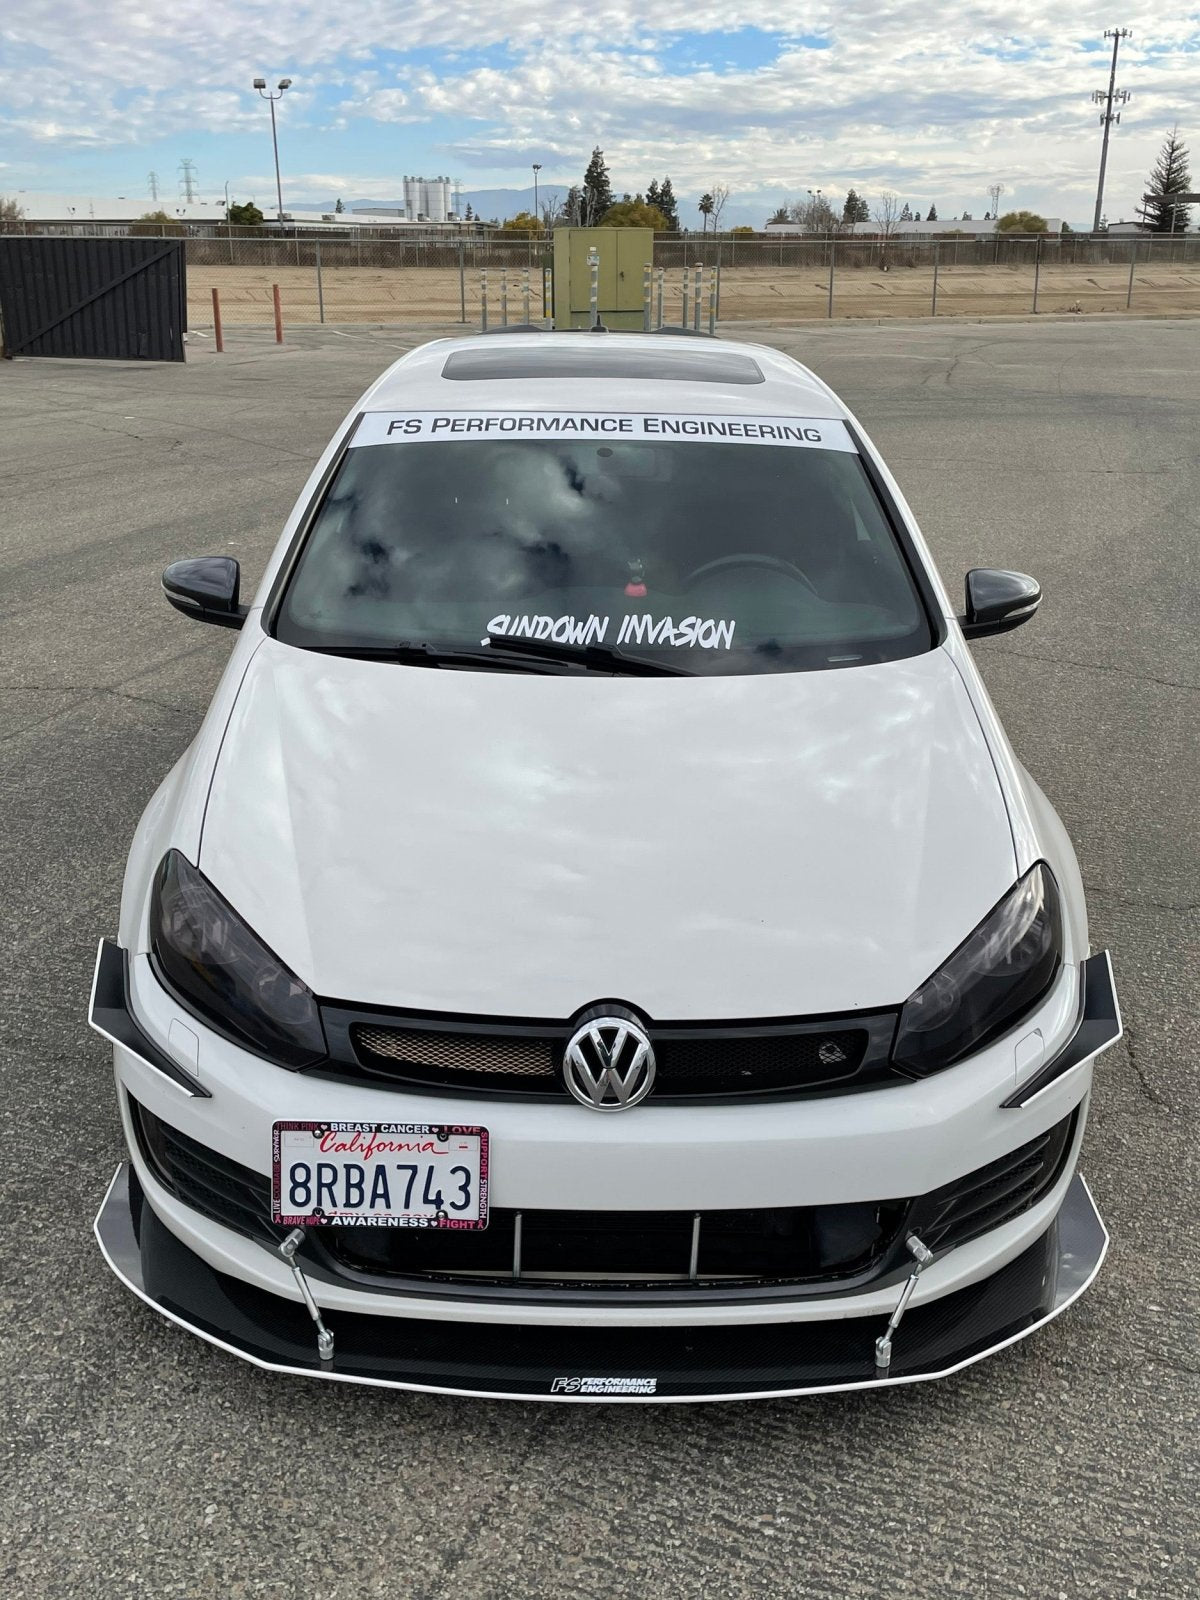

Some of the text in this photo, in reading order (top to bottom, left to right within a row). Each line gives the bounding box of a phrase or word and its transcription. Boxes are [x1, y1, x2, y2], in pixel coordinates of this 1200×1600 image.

[386, 417, 822, 443] FS PERFORMANCE ENGINEERING
[480, 614, 735, 650] SUNDOWN INVASION
[330, 1123, 430, 1134] BREAST CANCER
[443, 1126, 481, 1135] LOVE
[320, 1131, 449, 1161] California
[480, 1131, 488, 1219] SUPPORT STRENGTH
[289, 1162, 472, 1211] 8RBA743
[273, 1199, 281, 1213] LIVE
[283, 1215, 305, 1225] BRAVE
[331, 1216, 429, 1227] AWARENESS
[439, 1218, 475, 1229] FIGHT
[550, 1377, 658, 1393] FS PERFORMANCE
[580, 1385, 656, 1394] ENGINEERING
